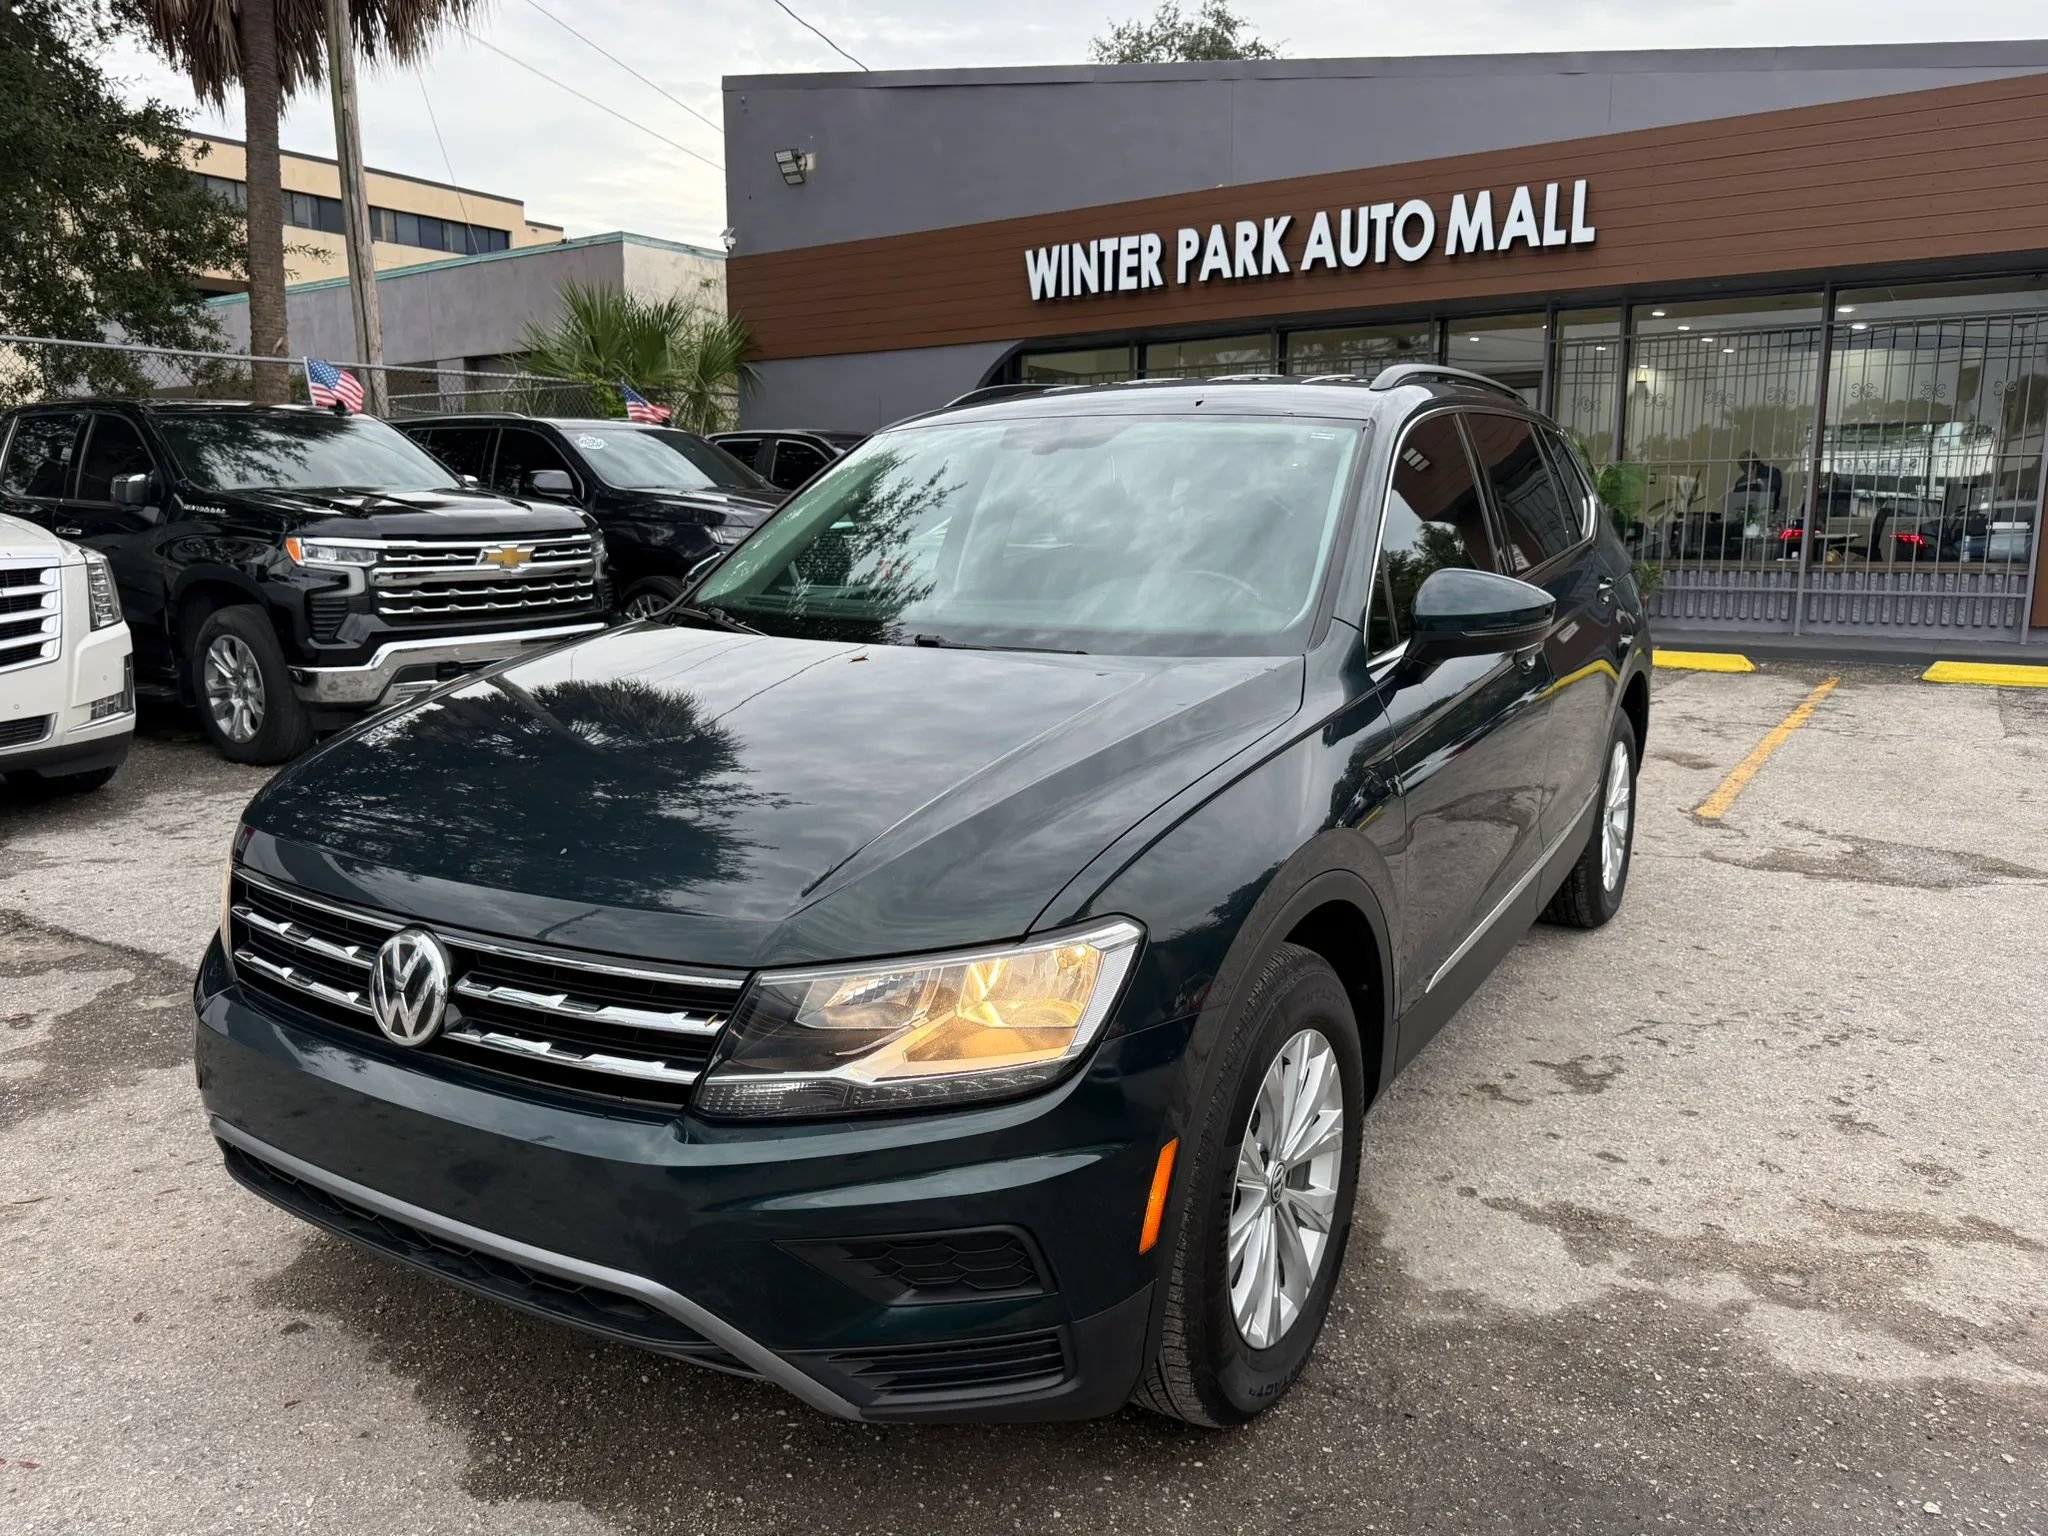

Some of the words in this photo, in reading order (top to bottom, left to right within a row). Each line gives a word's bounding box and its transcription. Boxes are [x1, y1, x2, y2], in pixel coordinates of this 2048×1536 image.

[1025, 233, 1163, 300] WINTER
[1177, 216, 1292, 284] PARK
[1301, 199, 1435, 271] AUTO
[1445, 179, 1595, 255] MALL
